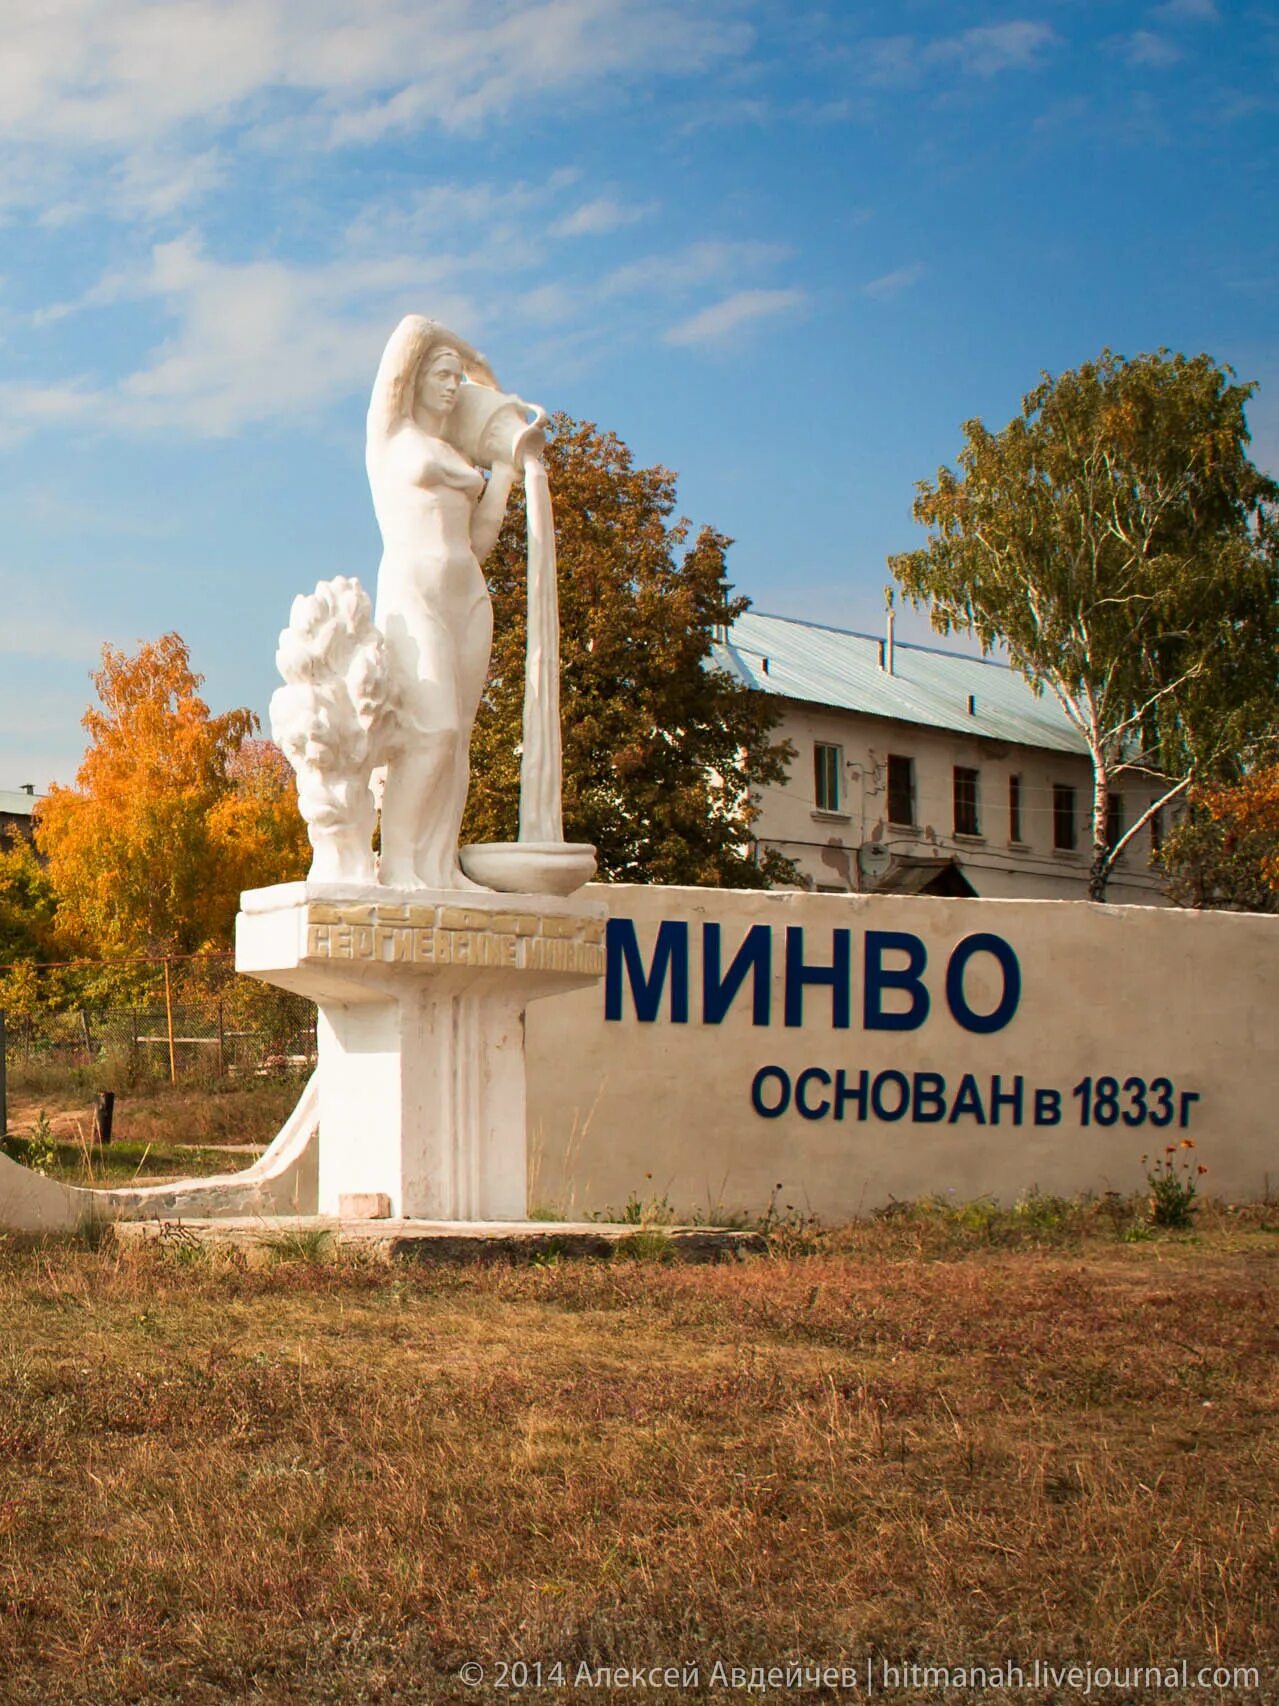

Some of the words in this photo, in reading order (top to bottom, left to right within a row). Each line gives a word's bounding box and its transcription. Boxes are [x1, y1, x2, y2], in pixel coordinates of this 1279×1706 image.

[605, 918, 1021, 1033] МИНВО
[751, 1065, 1023, 1125] ОСНОВАН
[1034, 1089, 1062, 1126] в
